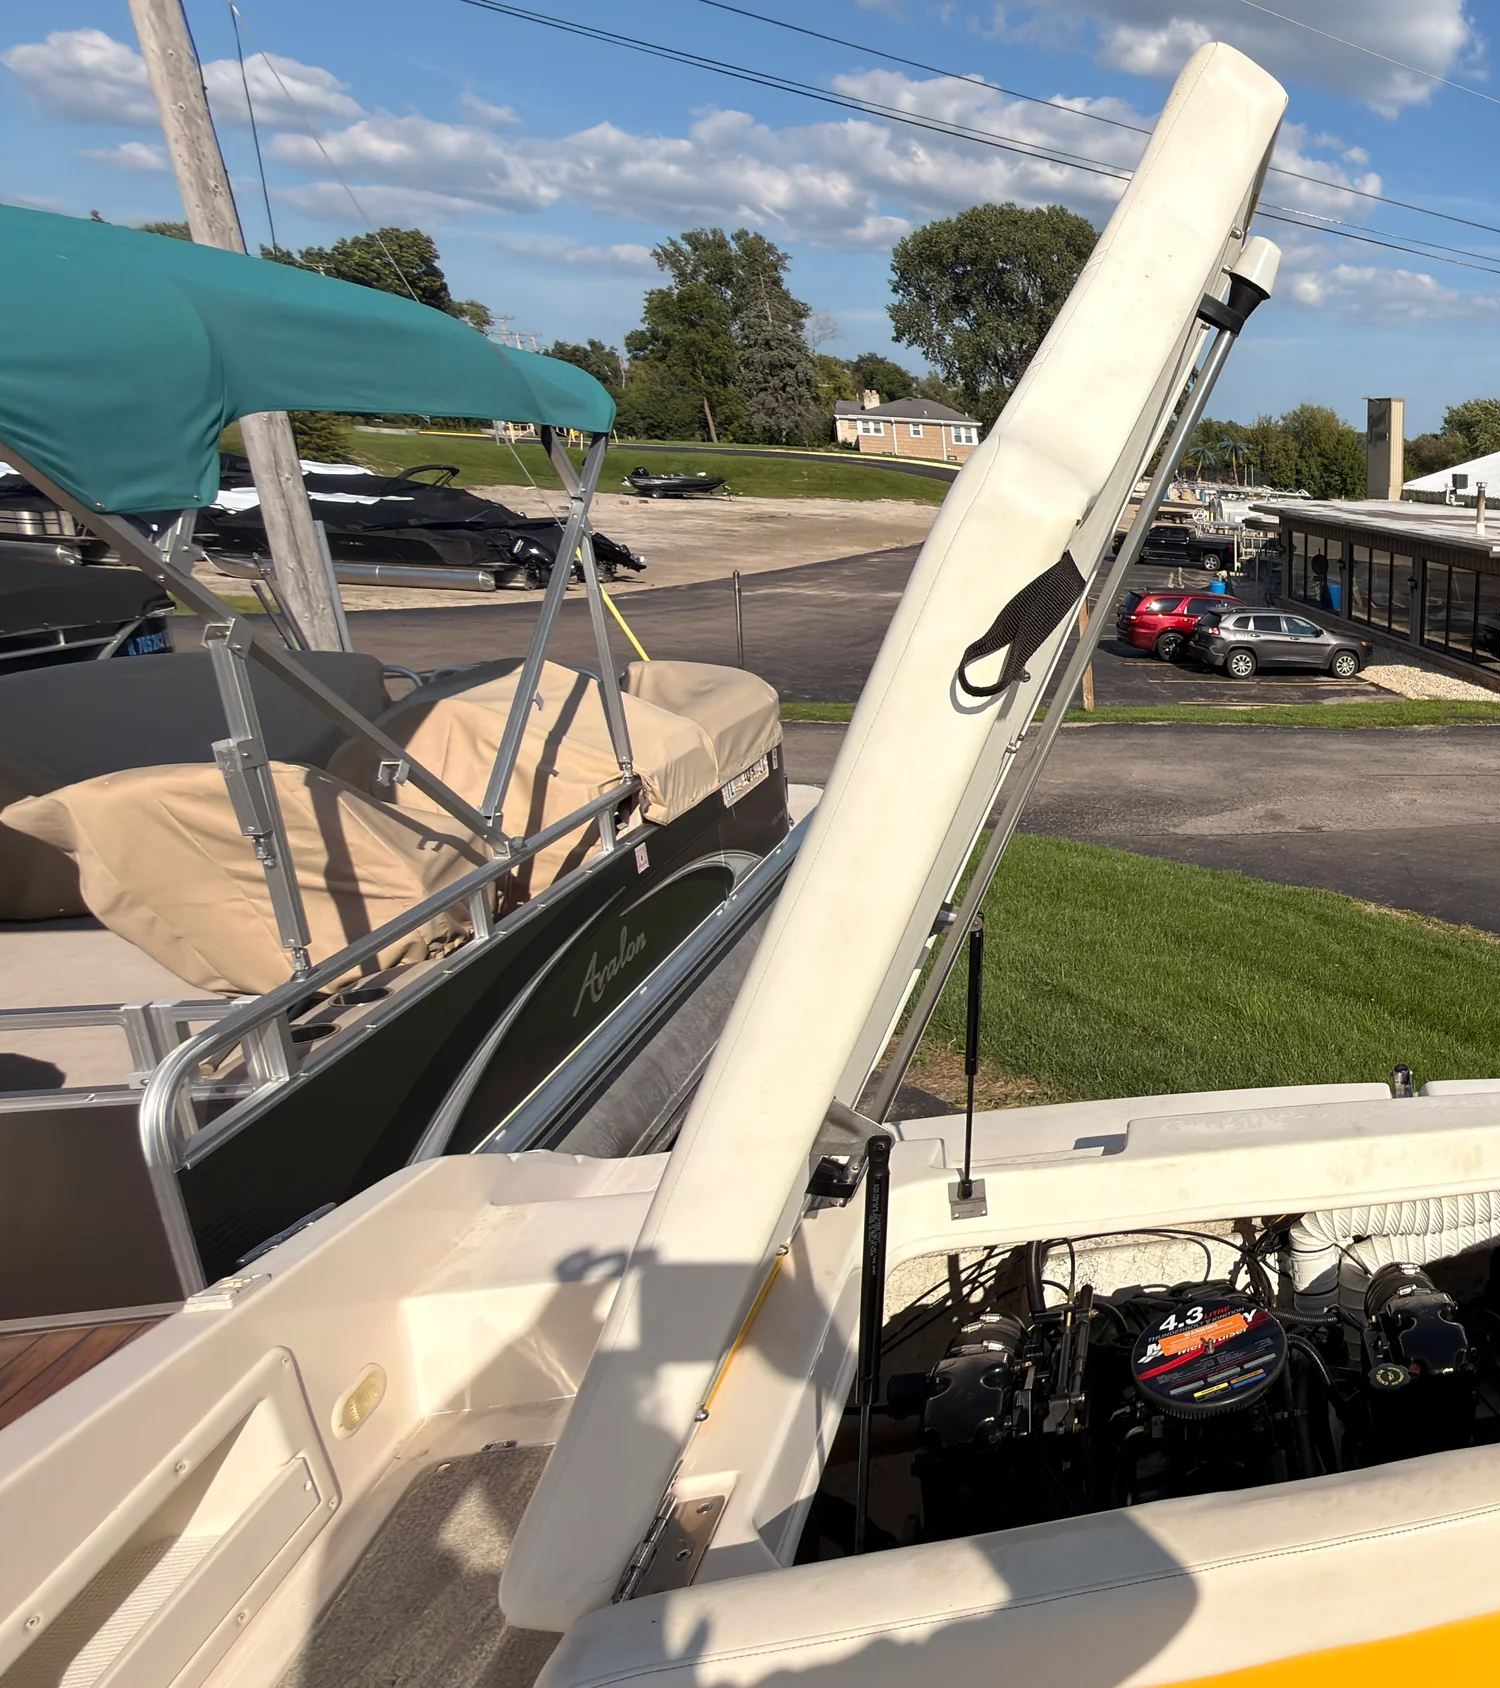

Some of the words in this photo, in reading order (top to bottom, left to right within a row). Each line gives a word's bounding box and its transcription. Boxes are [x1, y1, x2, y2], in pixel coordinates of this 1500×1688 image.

[572, 925, 647, 1018] Avalon
[1159, 1306, 1204, 1331] 4.3
[1183, 1323, 1219, 1337] WARNING
